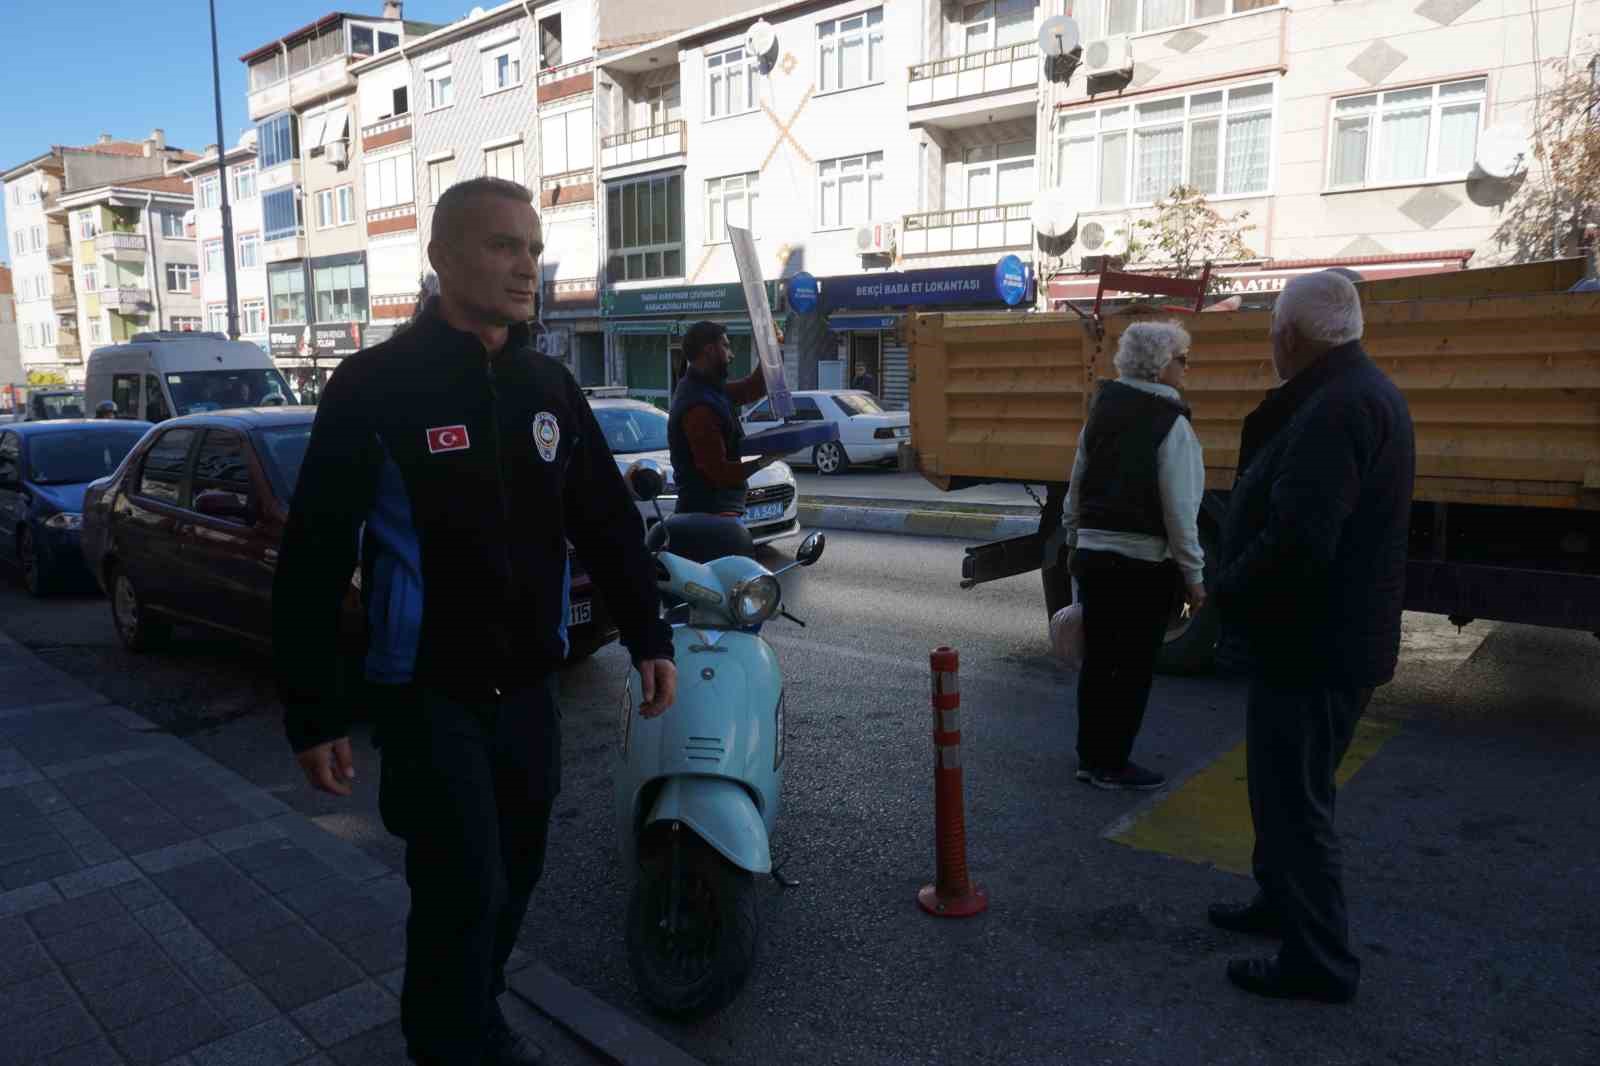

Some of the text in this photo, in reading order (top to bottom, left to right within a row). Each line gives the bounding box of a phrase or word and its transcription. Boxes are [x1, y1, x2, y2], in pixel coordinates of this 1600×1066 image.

[856, 279, 980, 296] BEKÇİ BABA ET LOKANTASI
